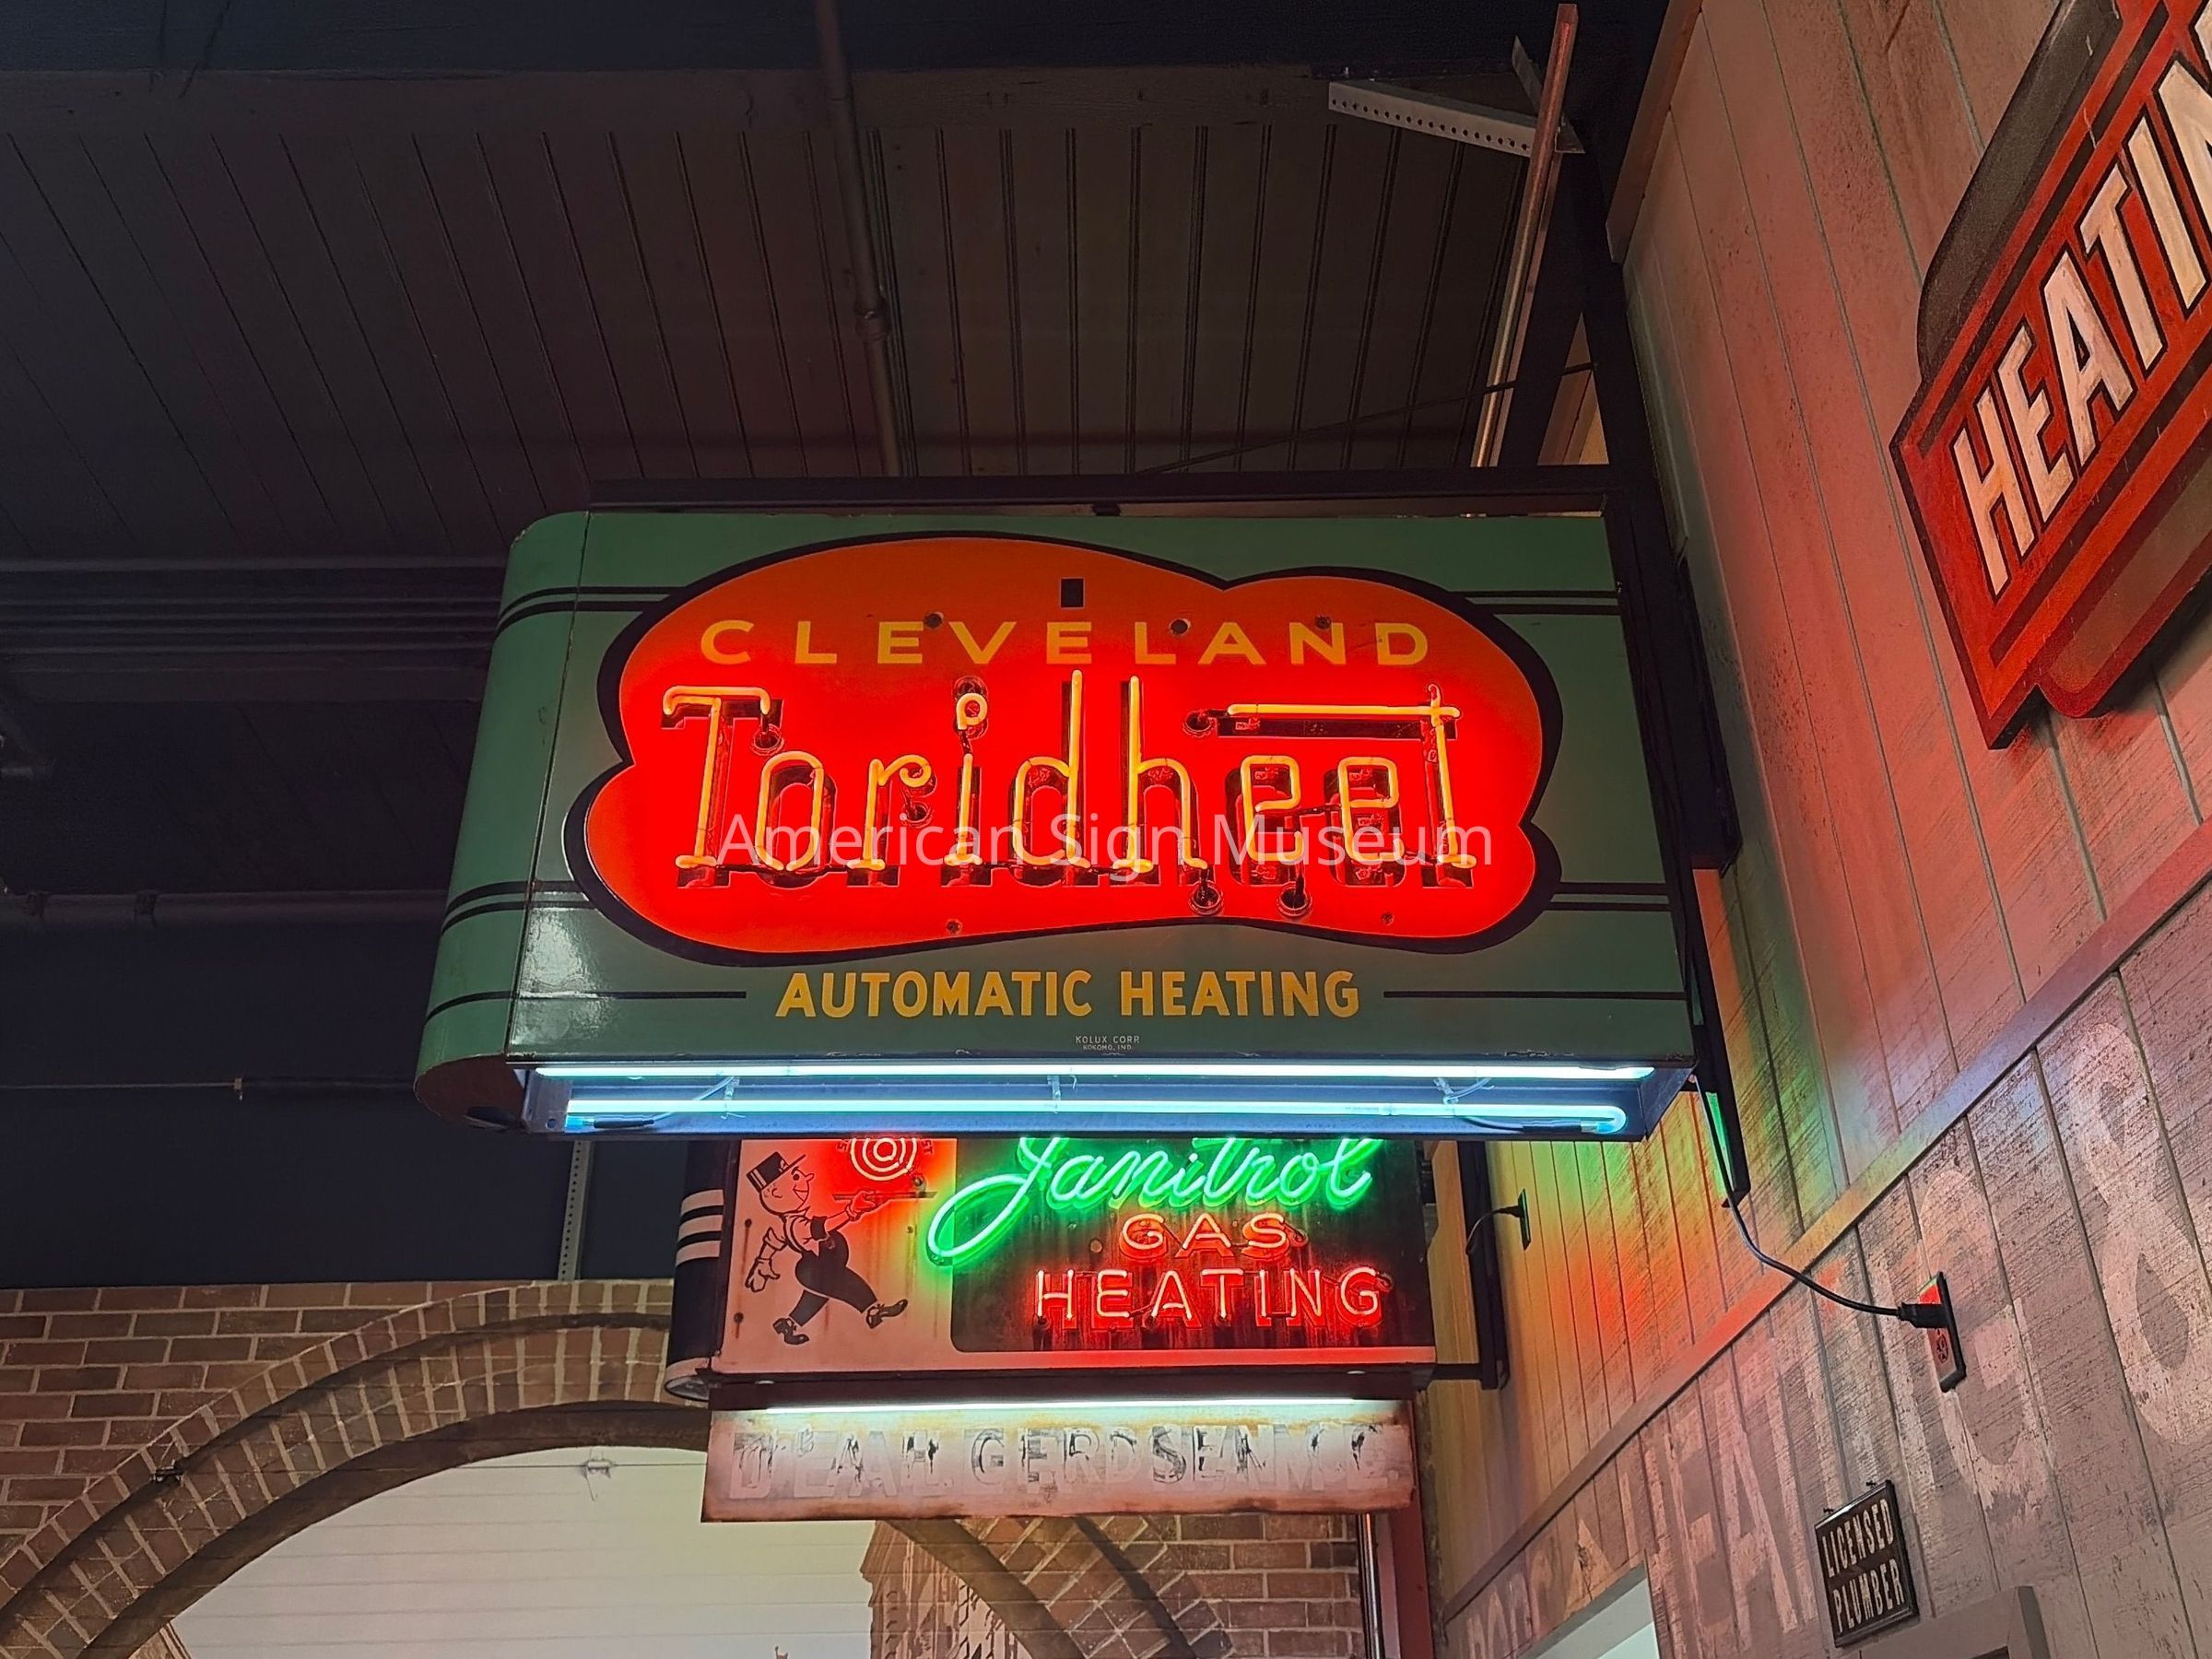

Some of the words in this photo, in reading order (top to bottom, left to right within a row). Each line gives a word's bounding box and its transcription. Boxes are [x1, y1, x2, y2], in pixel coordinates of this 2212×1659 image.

[700, 619, 1429, 665] CLEVELAND
[660, 668, 1477, 888] Toridheet
[775, 971, 1094, 1018] AUTOMATIC
[1120, 971, 1360, 1018] HEATING
[1075, 1035, 1108, 1044] KOLUX
[927, 1138, 1382, 1266] Janitrol
[1118, 1213, 1292, 1259] GAS
[1035, 1266, 1384, 1330] HEATING
[1821, 1498, 1895, 1579] LICENSED
[1833, 1558, 1905, 1633] PLUMBER
